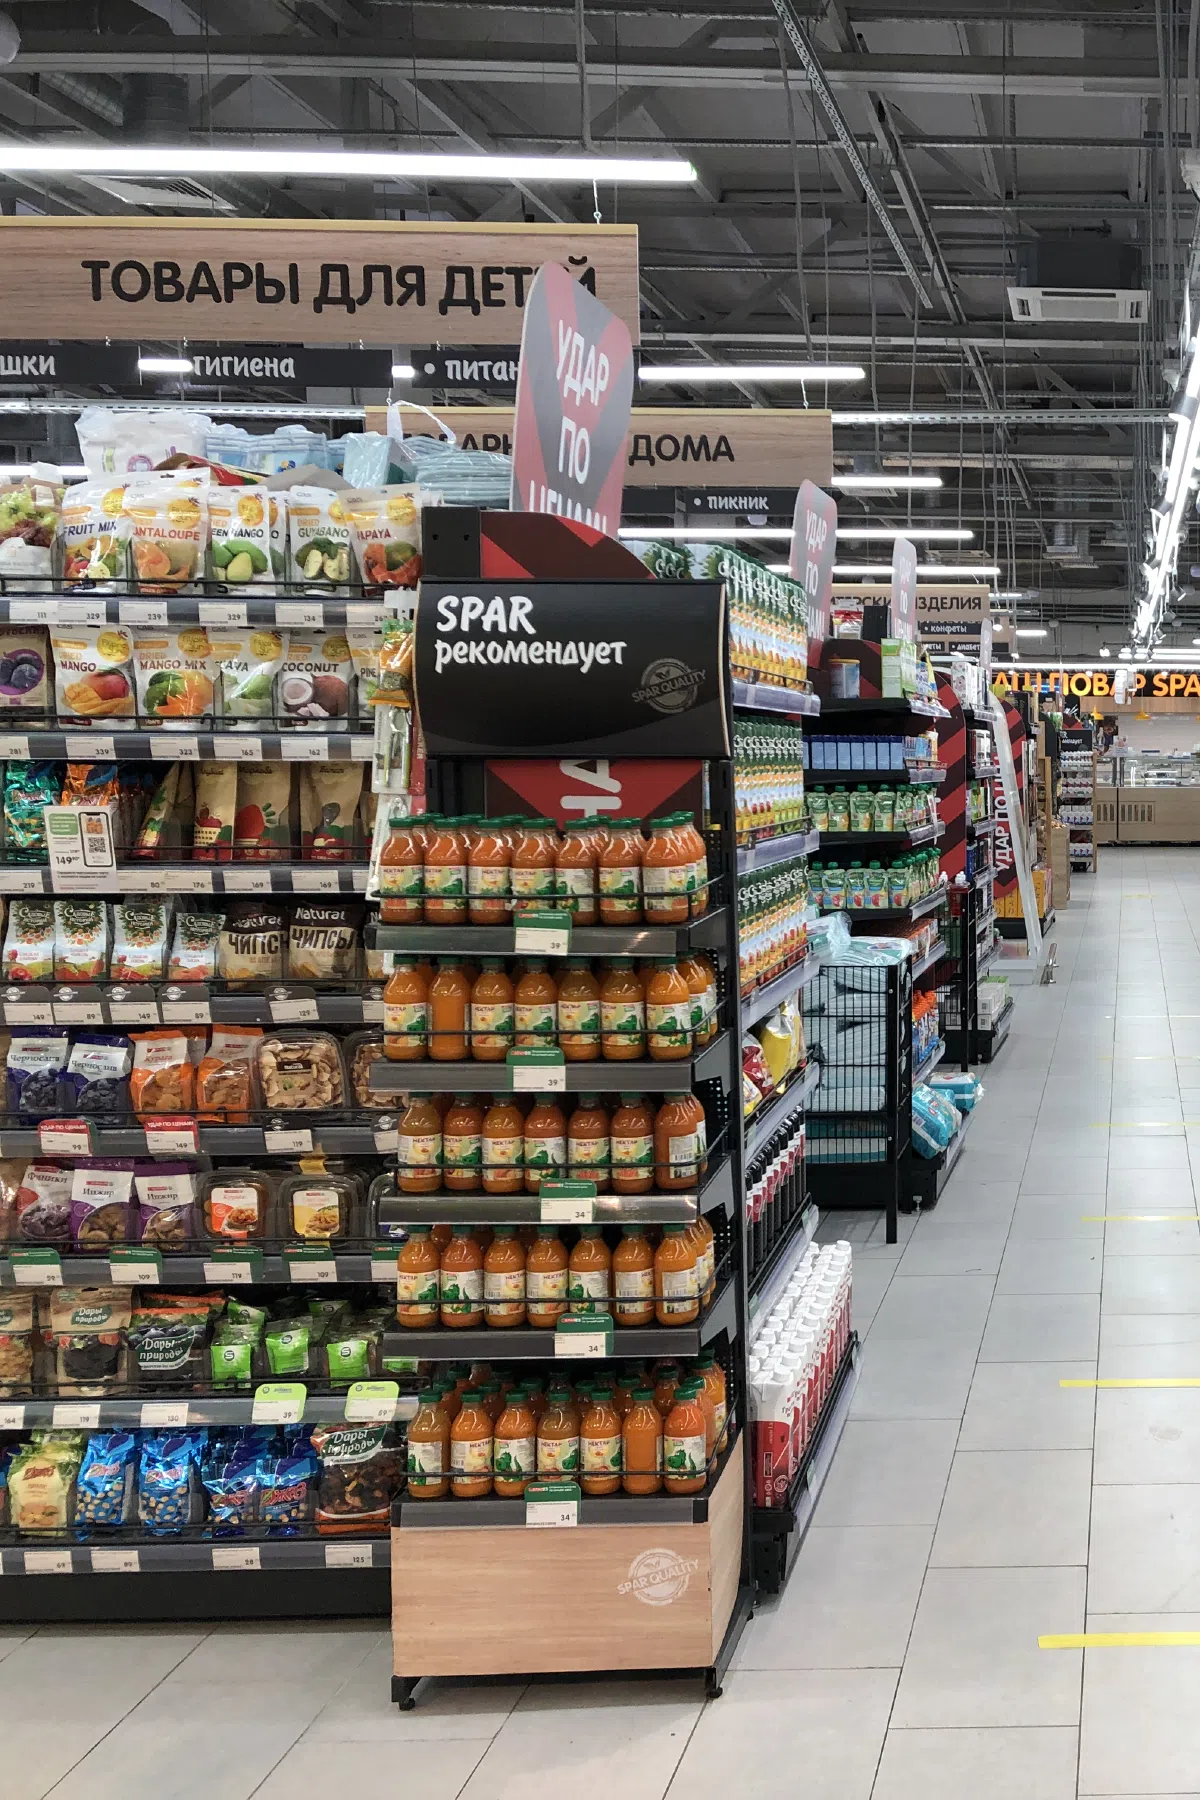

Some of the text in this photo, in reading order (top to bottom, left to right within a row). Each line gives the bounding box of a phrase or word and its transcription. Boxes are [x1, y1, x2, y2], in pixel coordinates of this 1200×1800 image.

[81, 259, 300, 304] ТОВАРЫ
[313, 263, 426, 314] ДЛЯ
[0, 355, 55, 376] шки
[556, 319, 610, 407] УДАР
[558, 416, 591, 485] ПО
[628, 434, 735, 466] ДОМА
[706, 496, 770, 511] пикник
[62, 521, 117, 536] FRUIT MIX
[806, 509, 828, 552] УДАР
[806, 560, 819, 596] ПО
[436, 595, 537, 635] SPAR
[435, 639, 627, 673] рекомендует
[60, 660, 96, 672] MANGO
[140, 660, 207, 670] MANGO MIX
[281, 662, 339, 673] COCONUT
[631, 668, 706, 704] SPAR QUALITY
[56, 856, 72, 865] 149
[295, 907, 346, 921] Natural
[291, 928, 354, 949] ЧИПСЫ
[27, 1171, 68, 1184] Финики
[83, 1188, 114, 1198] Инжир
[147, 1192, 178, 1201] Инжир
[75, 1314, 108, 1323] природы
[77, 1307, 103, 1317] Дары
[142, 1338, 175, 1350] Дары
[139, 1346, 184, 1361] природы
[333, 1431, 368, 1443] Дары
[328, 1438, 376, 1455] природы
[617, 1558, 699, 1596] SPAR QUALITY
